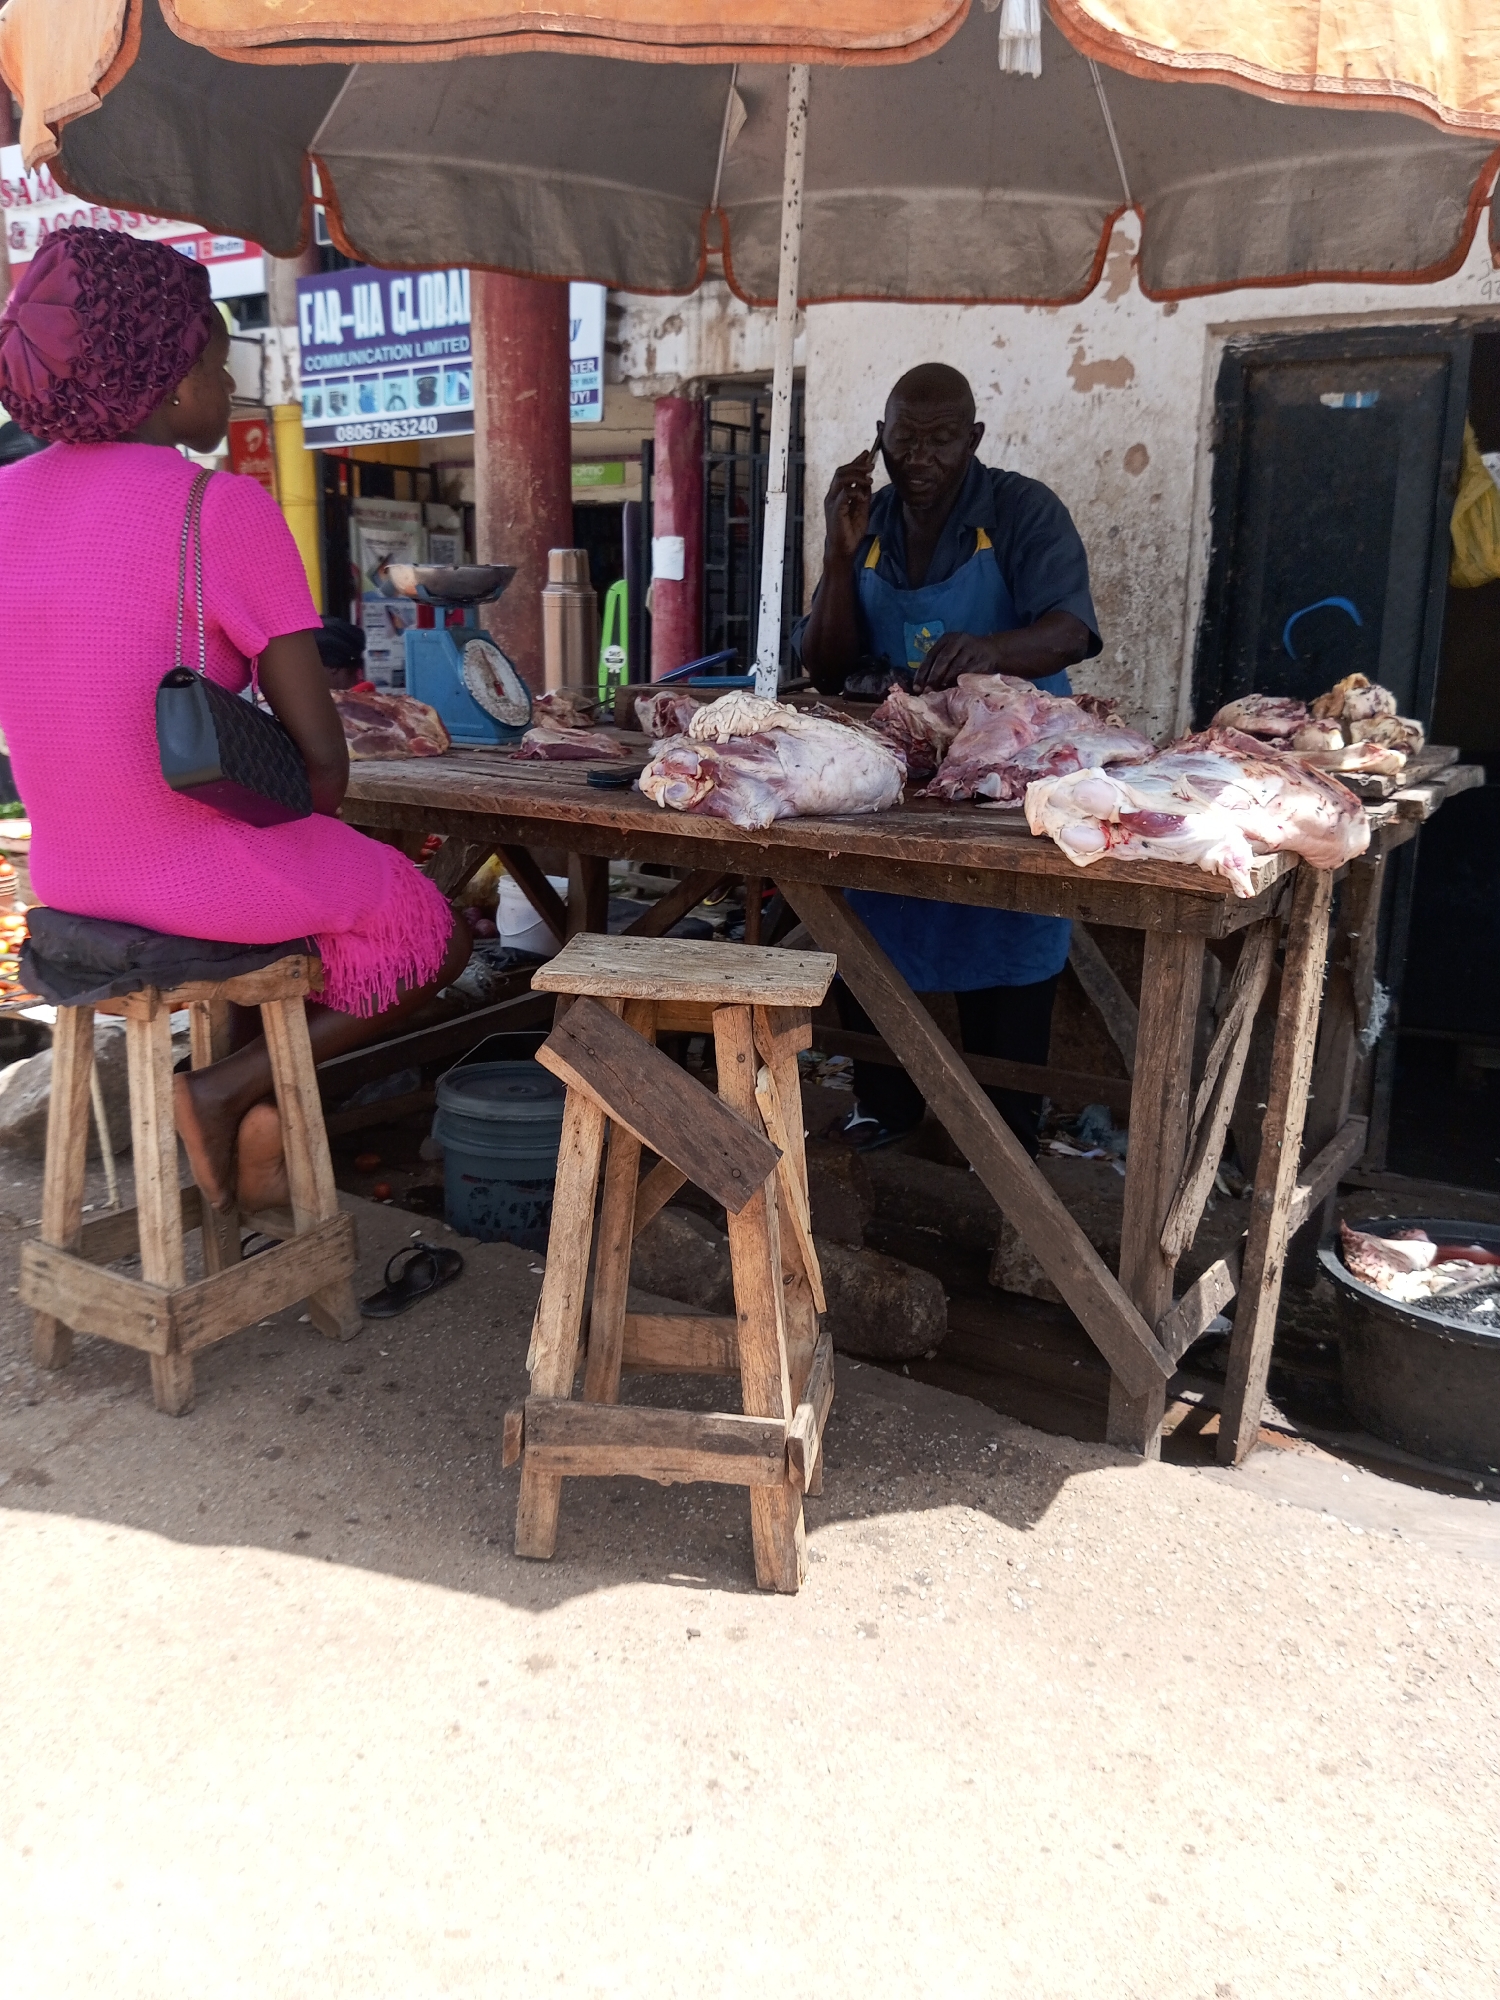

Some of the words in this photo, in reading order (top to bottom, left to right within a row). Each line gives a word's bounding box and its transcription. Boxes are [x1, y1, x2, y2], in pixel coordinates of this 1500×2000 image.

[0, 173, 68, 208] SAM
[390, 270, 471, 336] GLOBAL
[305, 343, 413, 371] COMMUNICATION
[415, 335, 470, 357] LIMITED
[335, 416, 438, 442] 08067963240
